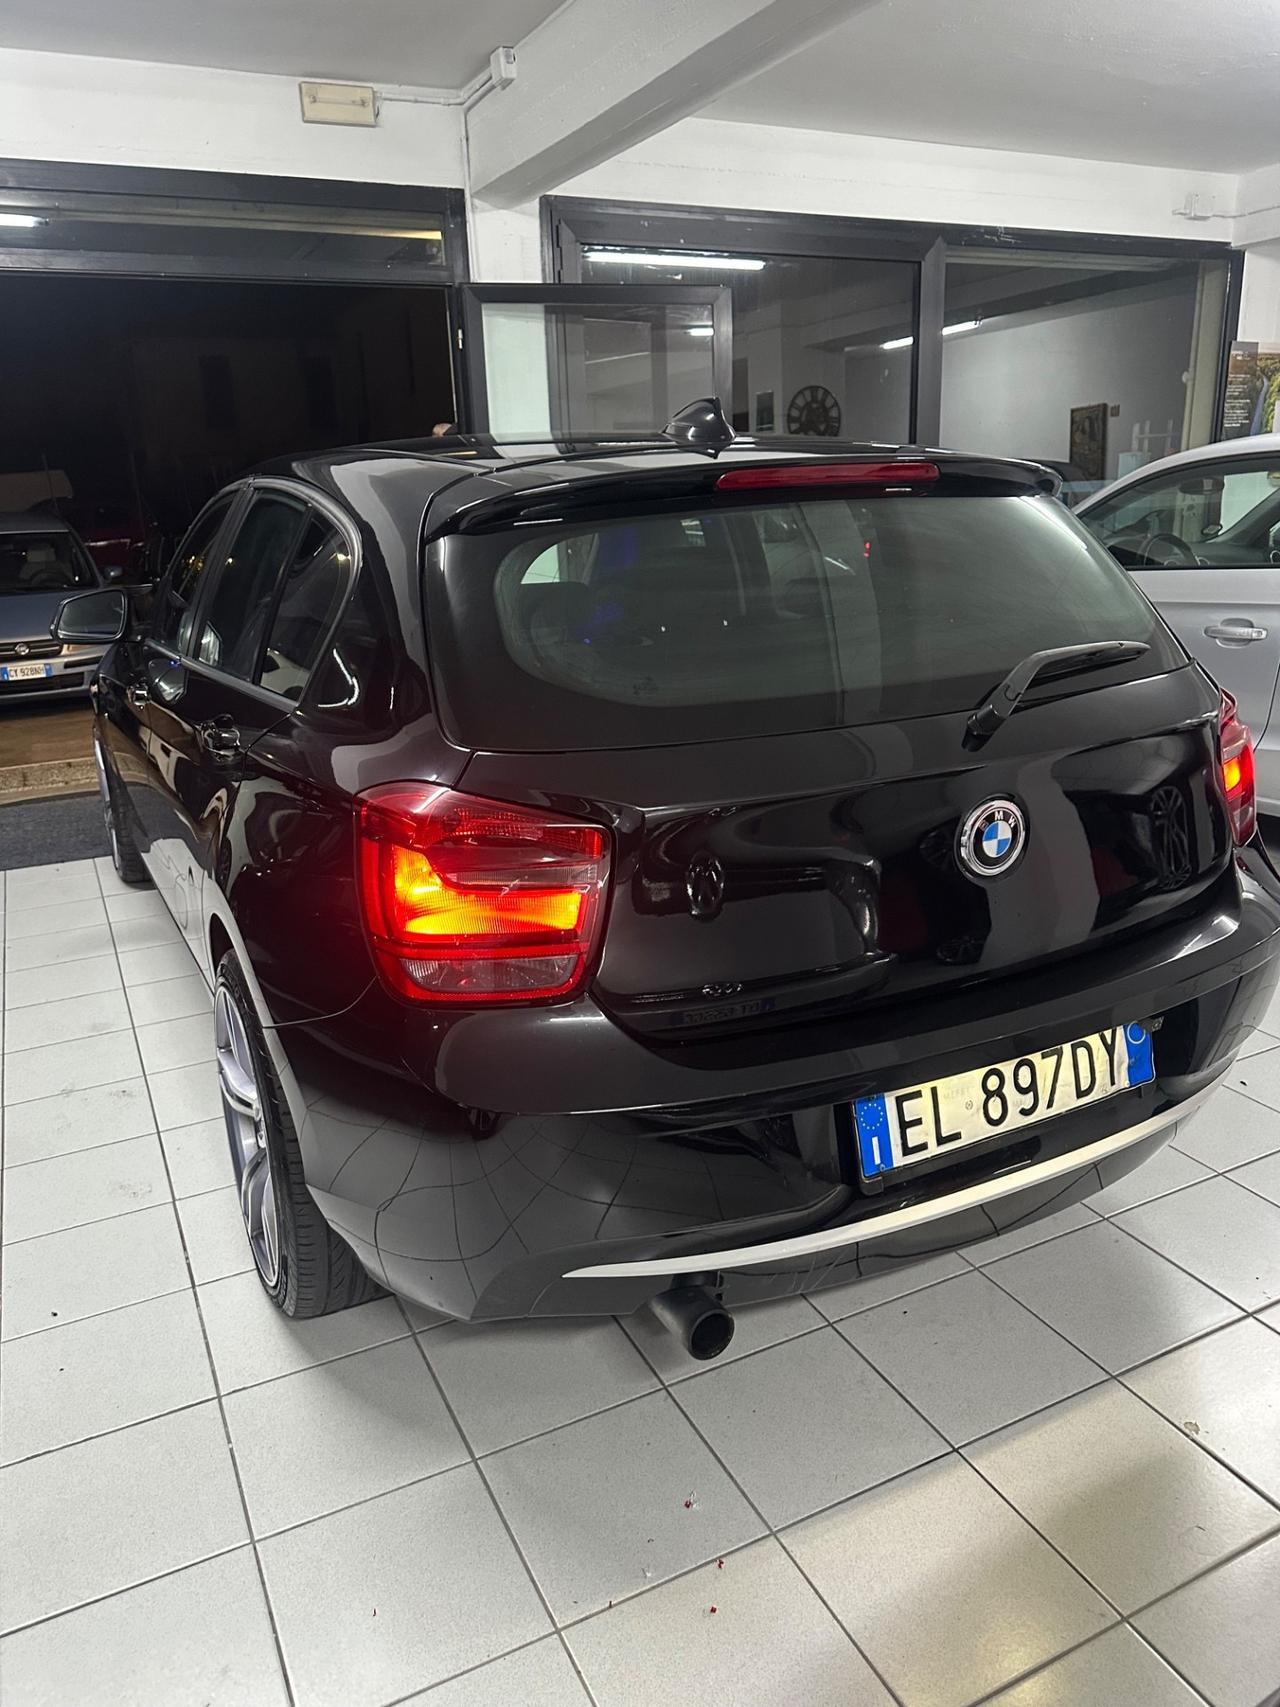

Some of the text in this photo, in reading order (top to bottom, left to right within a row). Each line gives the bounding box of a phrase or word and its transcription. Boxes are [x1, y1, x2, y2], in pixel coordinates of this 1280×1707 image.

[979, 810, 1017, 831] BMW
[895, 1028, 1117, 1157] EL 897DY
